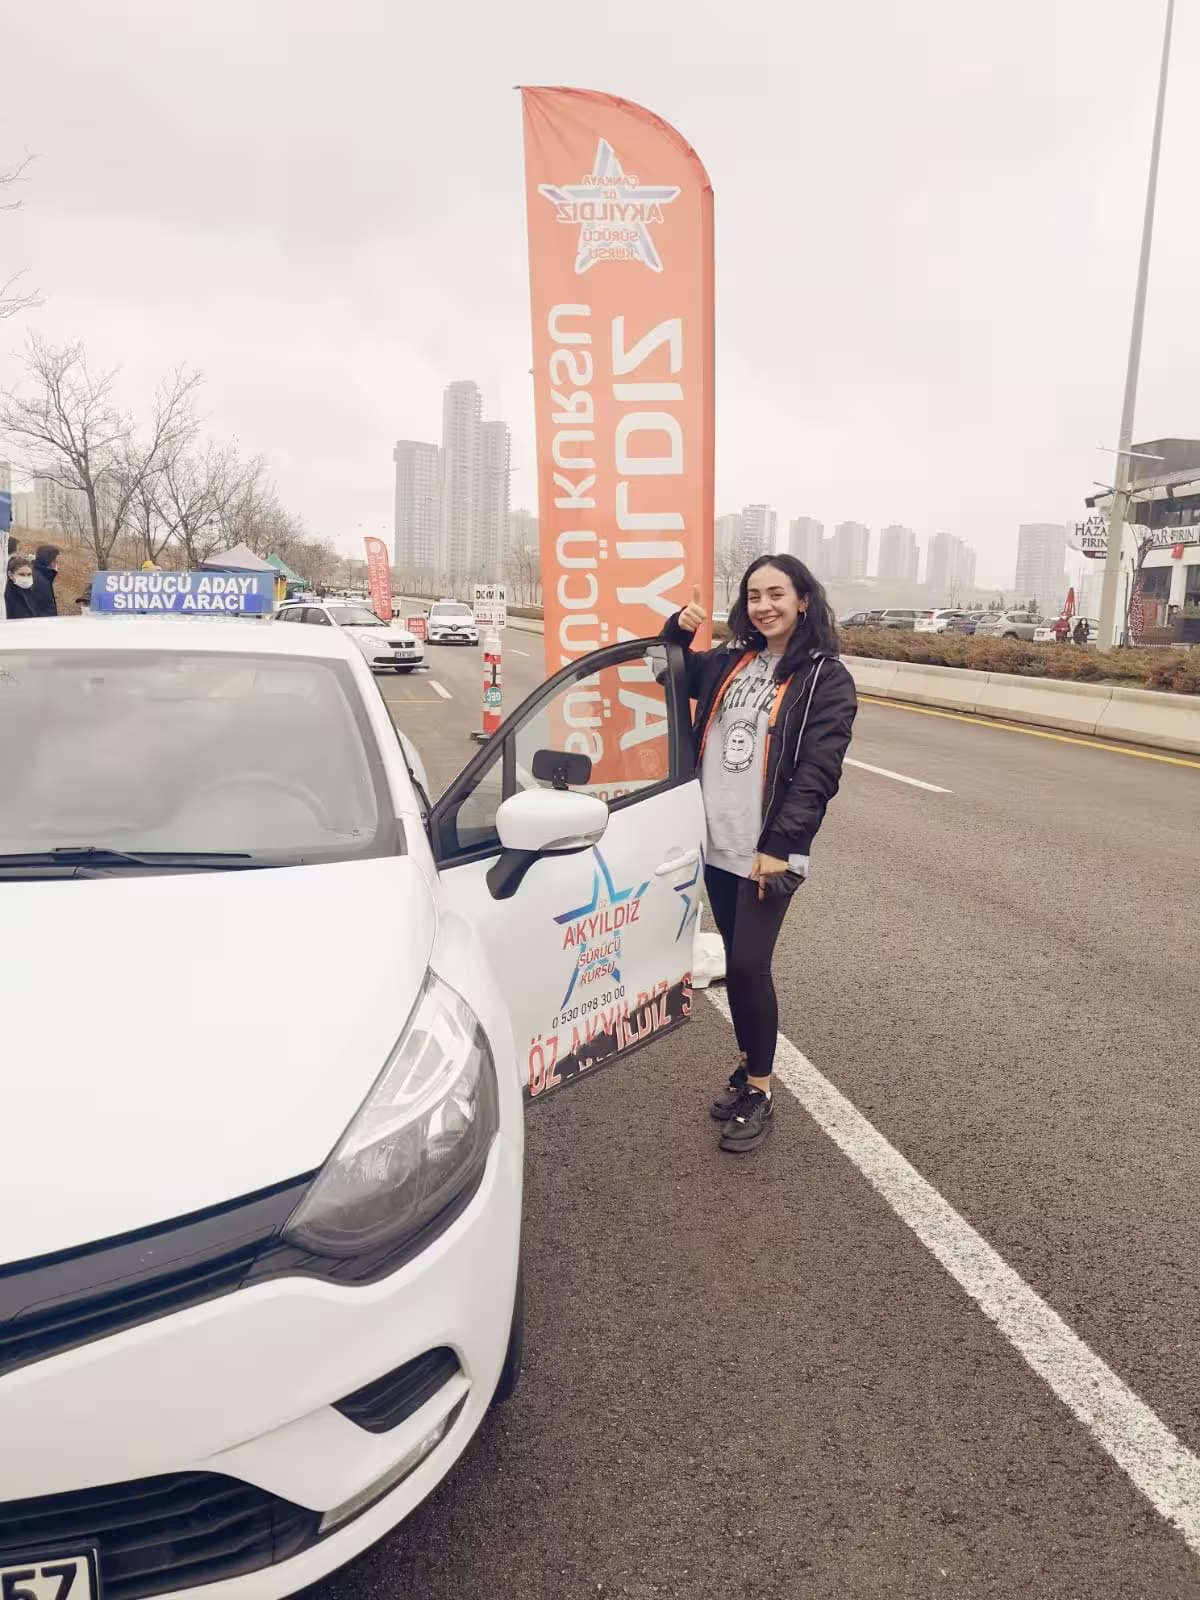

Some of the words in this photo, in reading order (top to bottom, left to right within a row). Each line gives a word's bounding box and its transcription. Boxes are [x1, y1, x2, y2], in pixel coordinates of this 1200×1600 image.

[1075, 522, 1108, 536] HAZA
[1086, 516, 1105, 526] ATA
[105, 572, 192, 593] SÜRÜCÜ
[197, 577, 258, 594] ADAYI
[113, 593, 177, 610] SINAV
[182, 595, 245, 610] ARACI
[562, 899, 641, 950] AKYILDIZ
[578, 936, 621, 967] SÜRÜCÜ
[580, 960, 615, 985] KURSU
[552, 1016, 559, 1029] 0
[561, 1007, 578, 1024] 530
[581, 997, 598, 1015] 098
[601, 991, 612, 1006] 30
[614, 985, 625, 1000] 00
[528, 1033, 562, 1096] ÖZ
